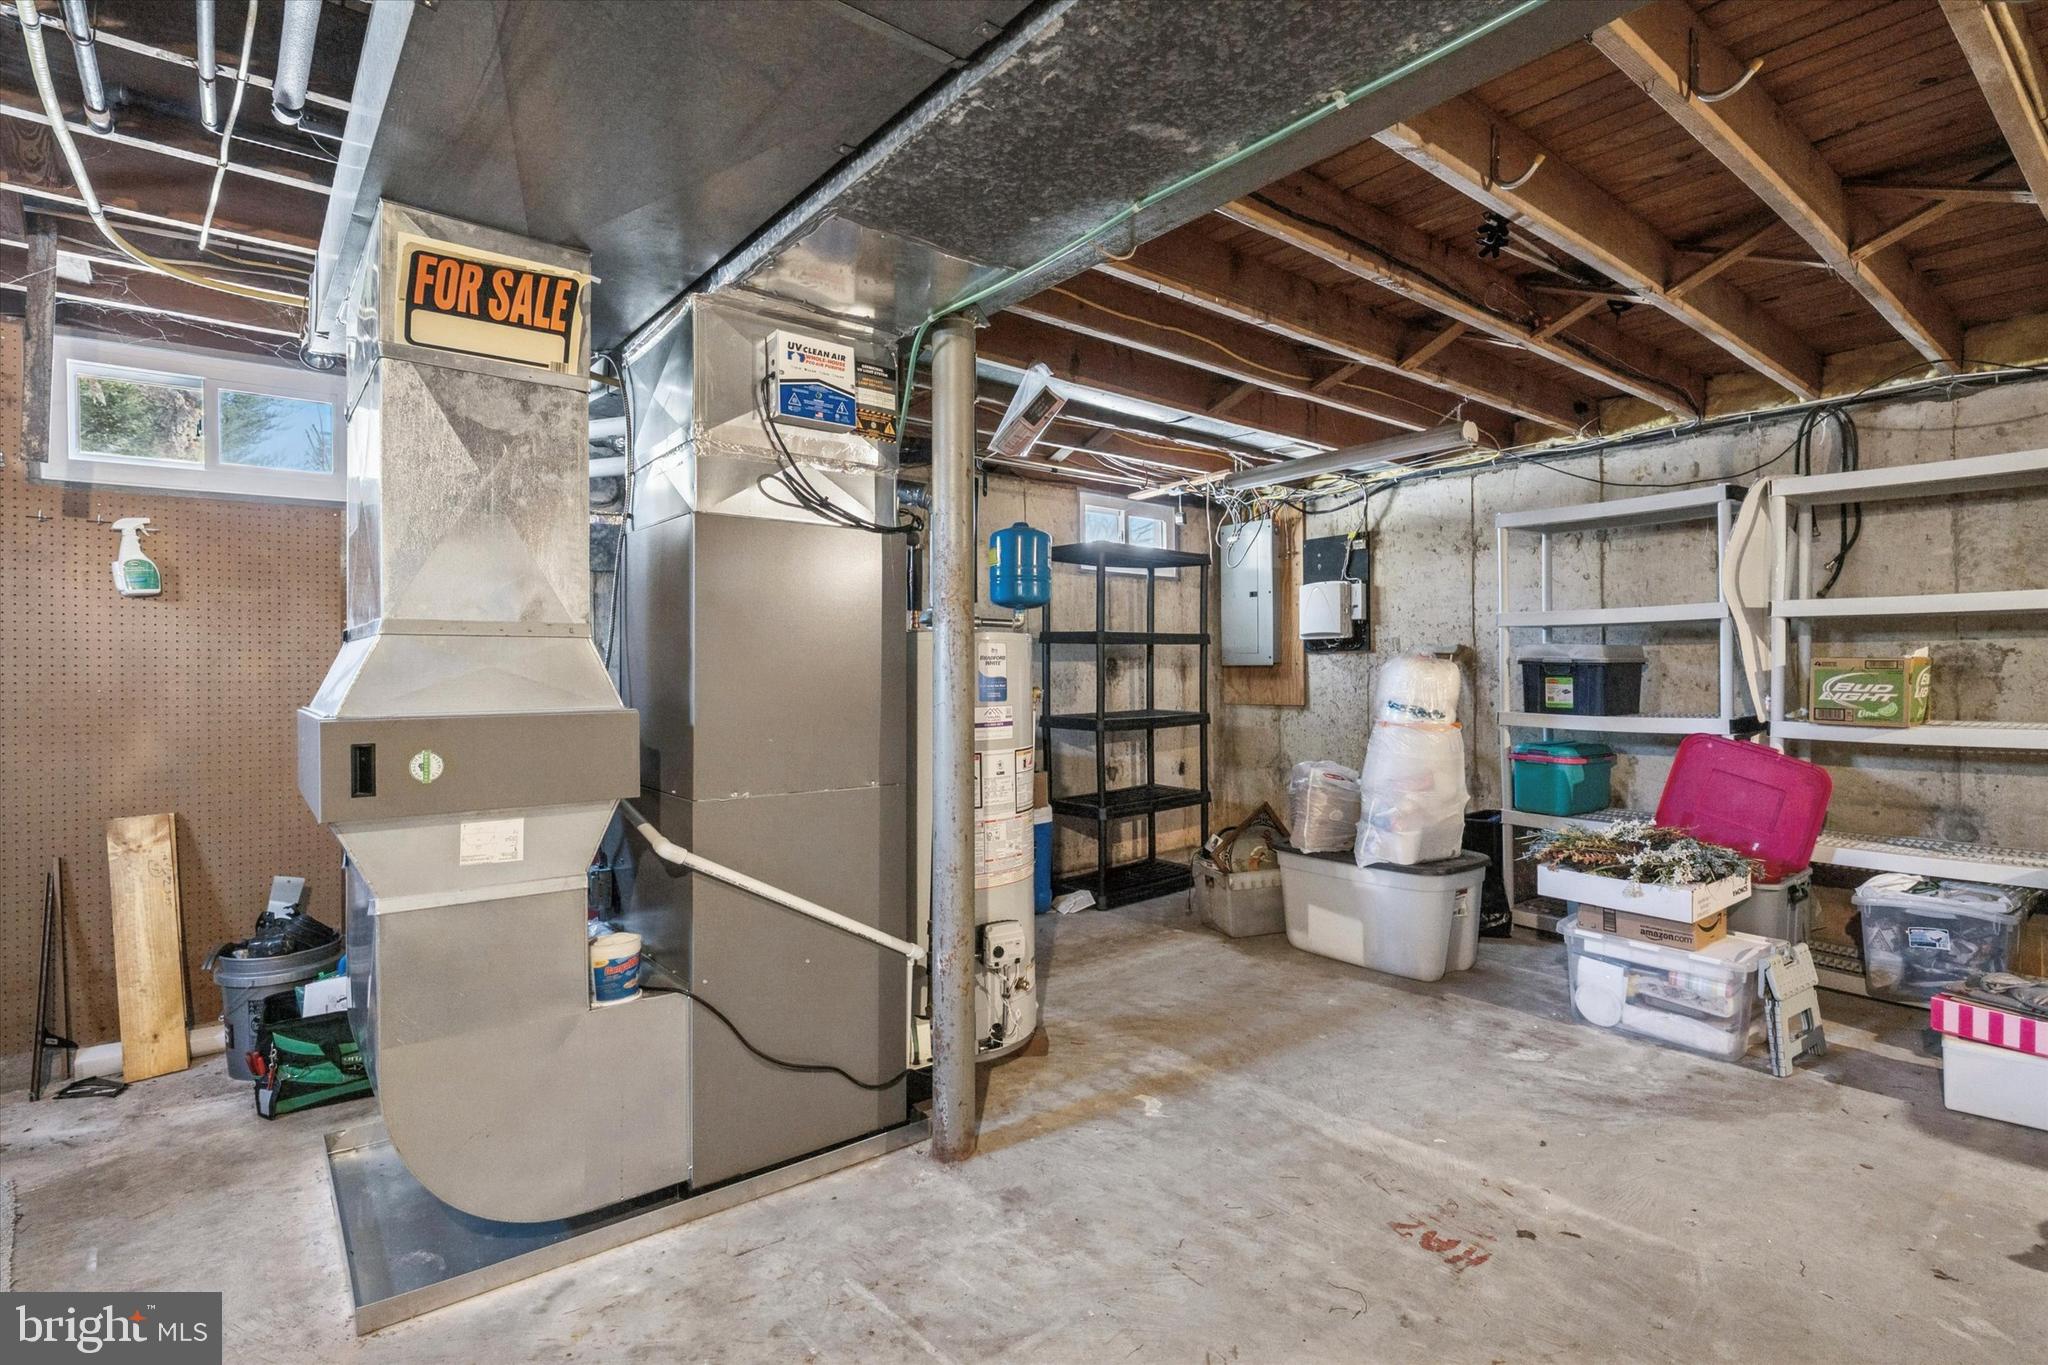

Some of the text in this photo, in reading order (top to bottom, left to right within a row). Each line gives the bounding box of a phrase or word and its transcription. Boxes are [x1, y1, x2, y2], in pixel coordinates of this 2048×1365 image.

[413, 254, 573, 332] FOR SALE
[787, 341, 846, 362] UV CLEAN AIR
[805, 354, 846, 367] WHOLE-HOUSE
[1832, 682, 1894, 693] BUD
[1818, 691, 1899, 702] LIGHT
[1640, 928, 1692, 944] amazon.com
